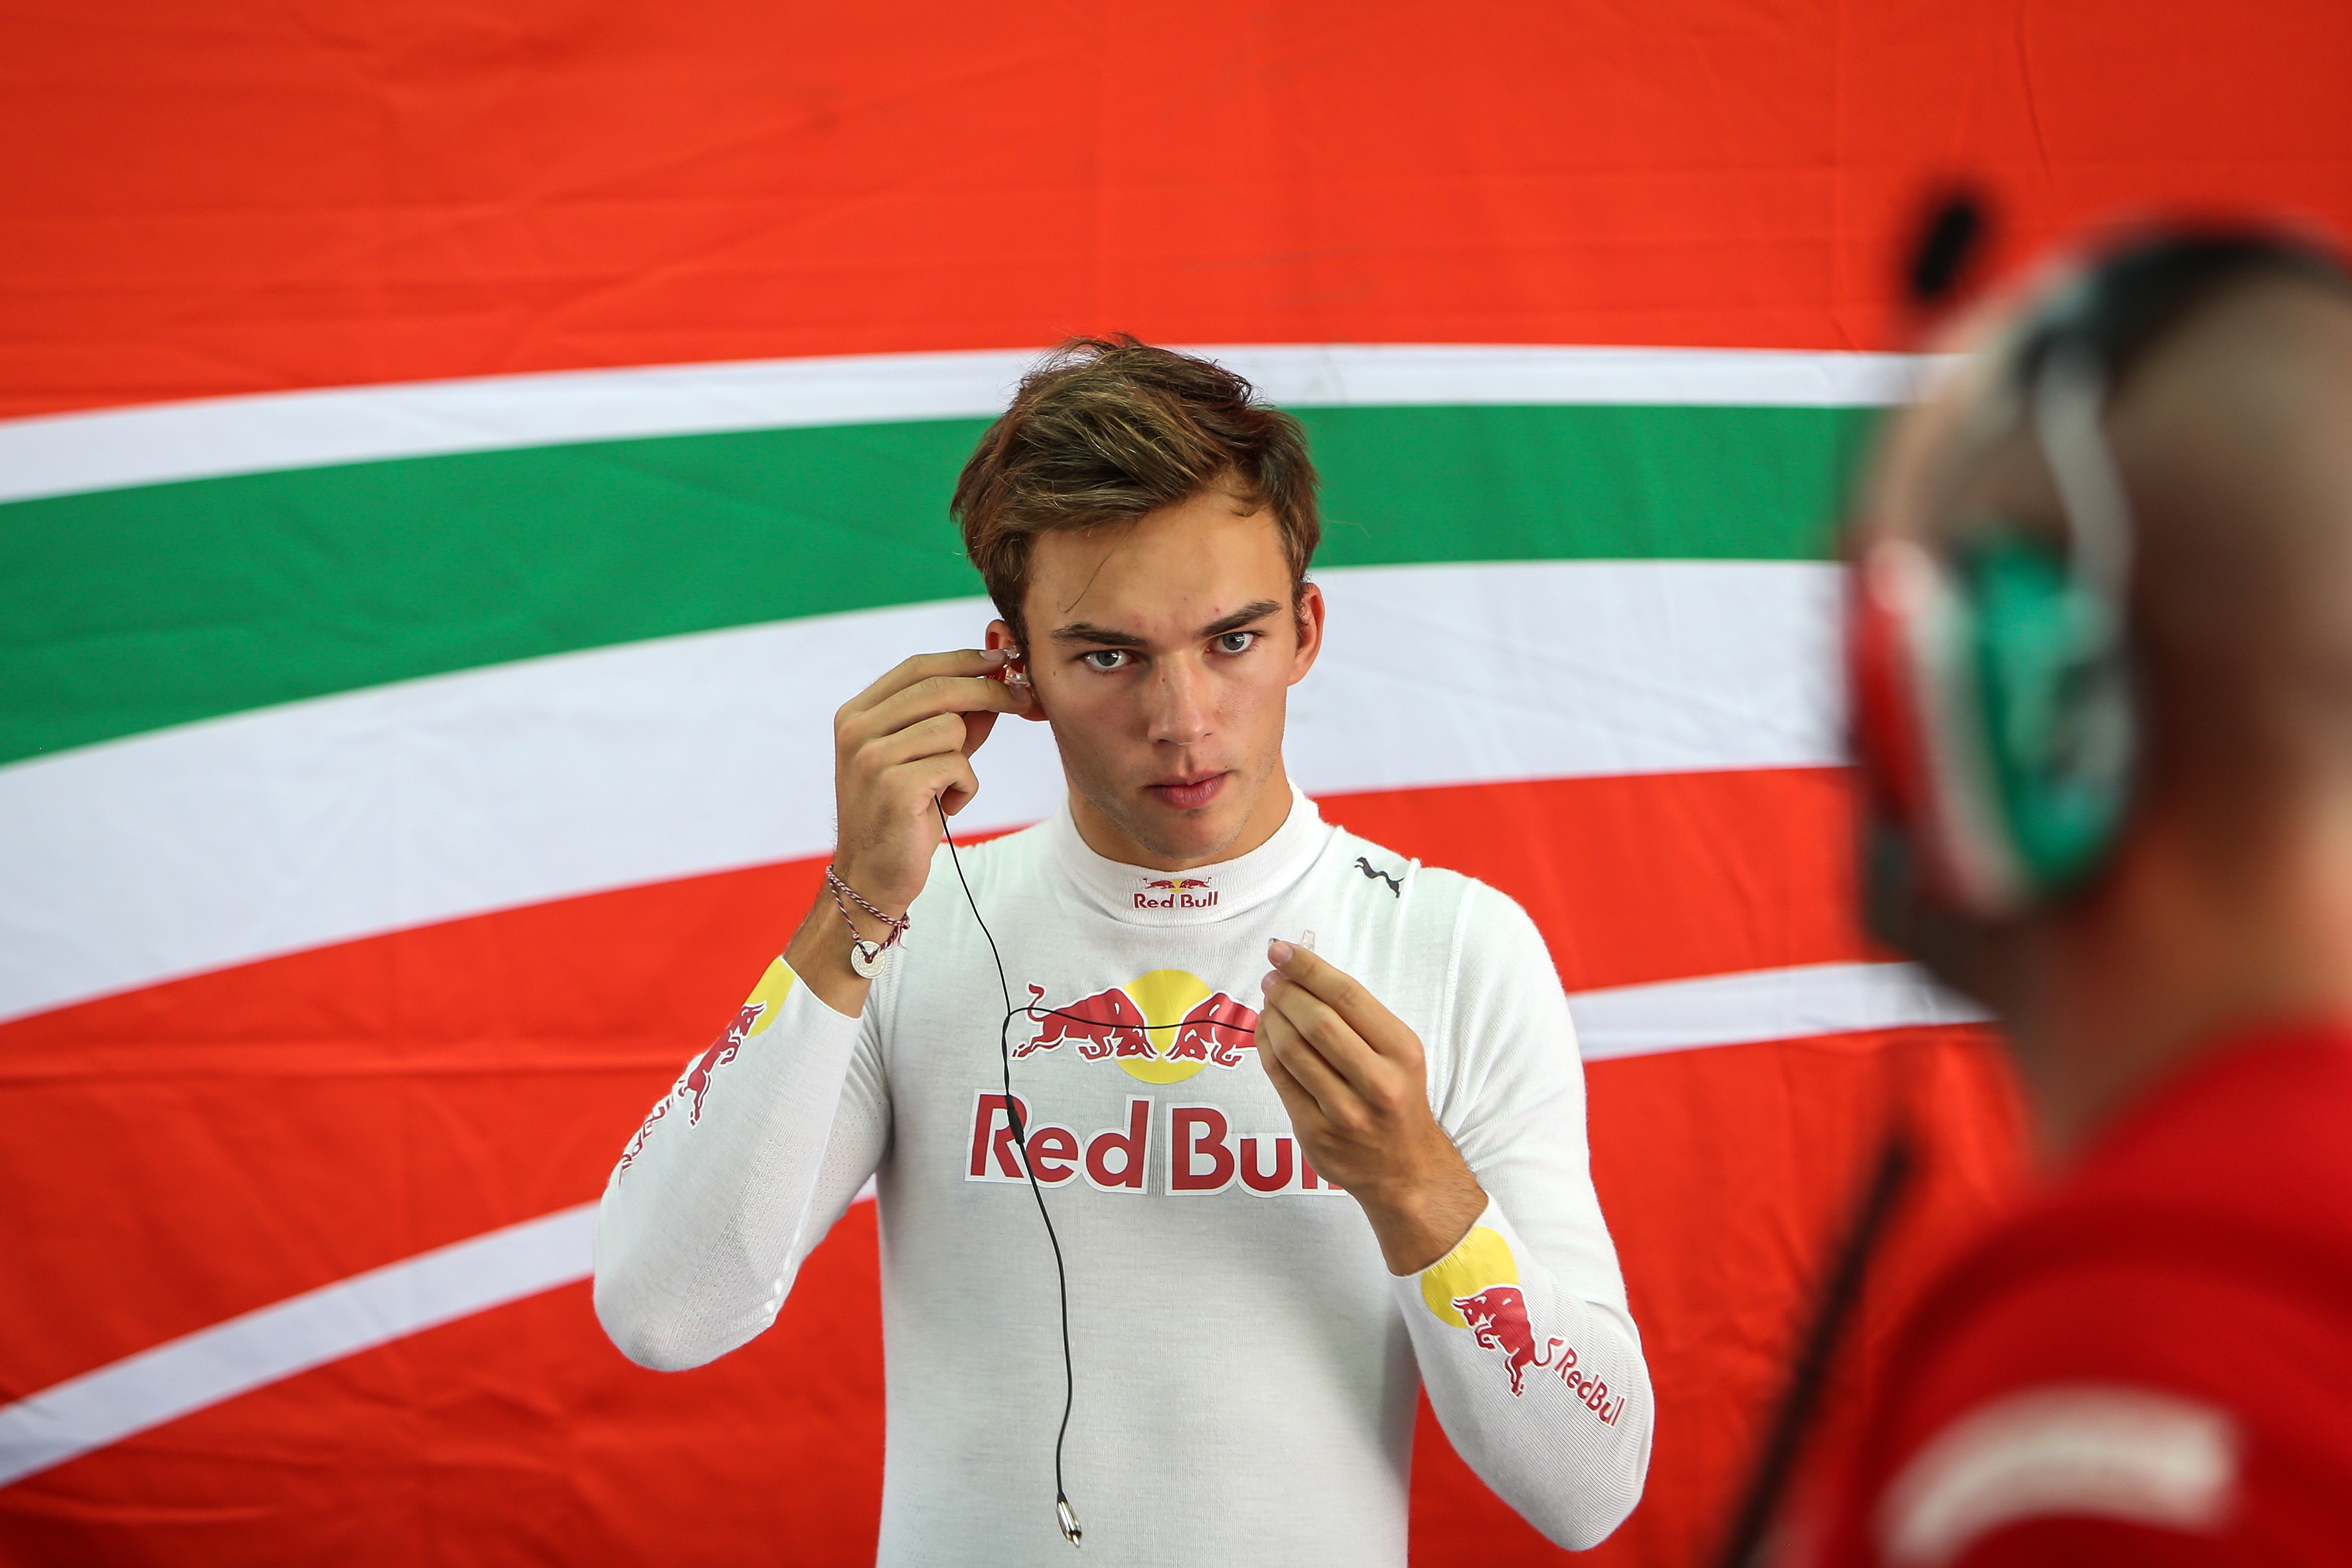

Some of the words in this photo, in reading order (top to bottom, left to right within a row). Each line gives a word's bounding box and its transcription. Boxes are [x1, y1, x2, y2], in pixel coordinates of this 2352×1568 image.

[1134, 893, 1175, 909] Red
[1180, 890, 1219, 908] Bull
[970, 1093, 1150, 1188] Red
[1172, 1107, 1344, 1192] Bu
